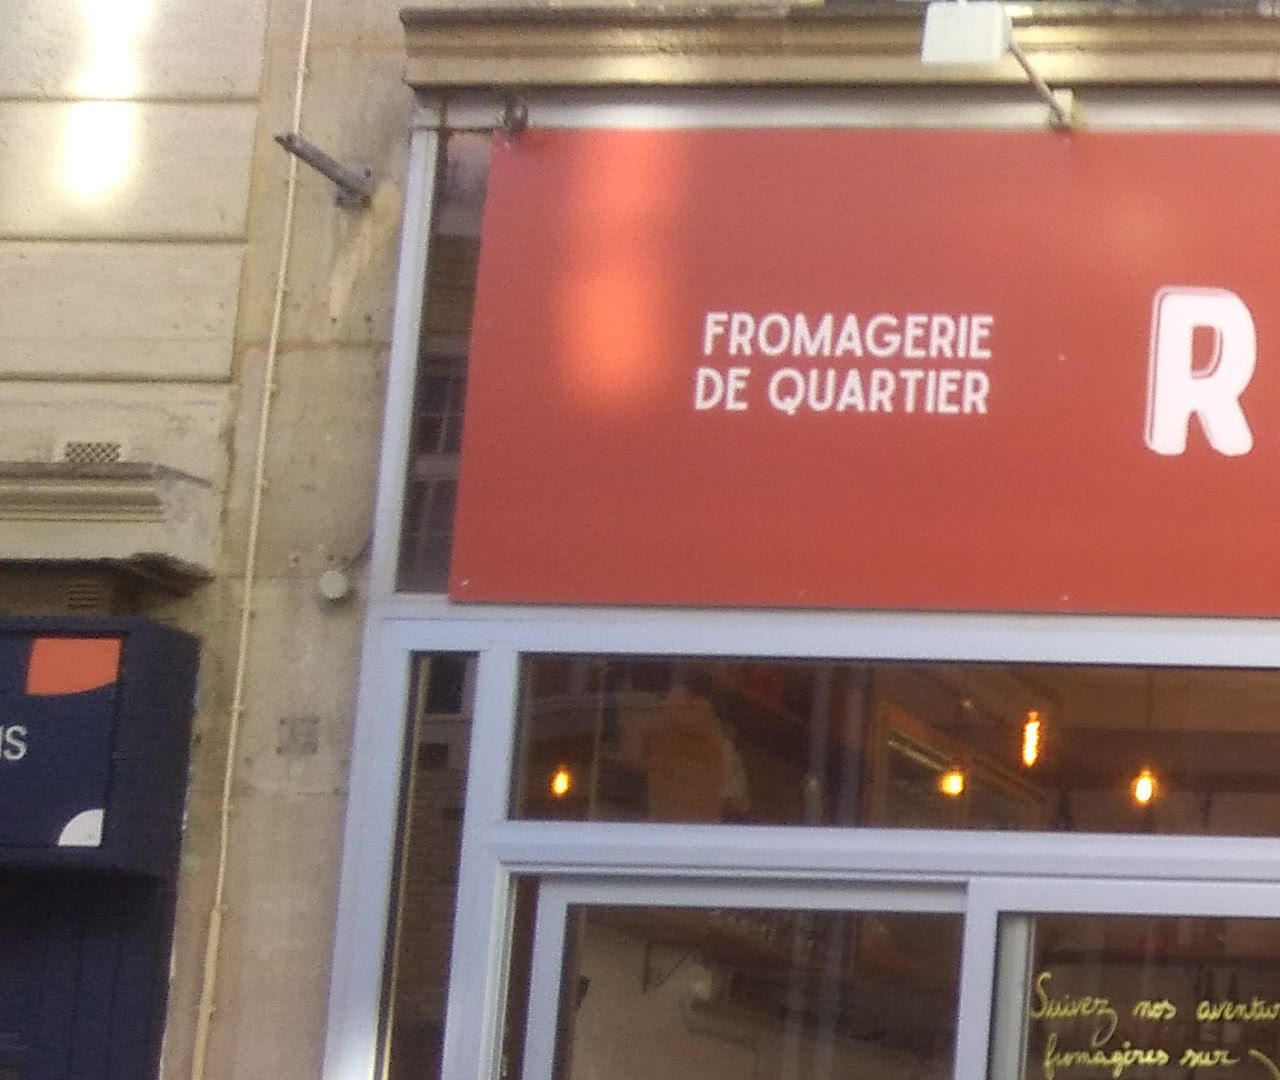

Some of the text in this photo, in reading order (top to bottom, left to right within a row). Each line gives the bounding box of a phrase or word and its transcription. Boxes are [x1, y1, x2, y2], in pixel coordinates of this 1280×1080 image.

[703, 311, 994, 359] FROMAGERIE
[694, 366, 991, 417] DE QUARTIER
[1029, 972, 1118, 1047] Suivez
[1132, 997, 1177, 1022] nos
[1043, 1034, 1240, 1080] fromagères sur
